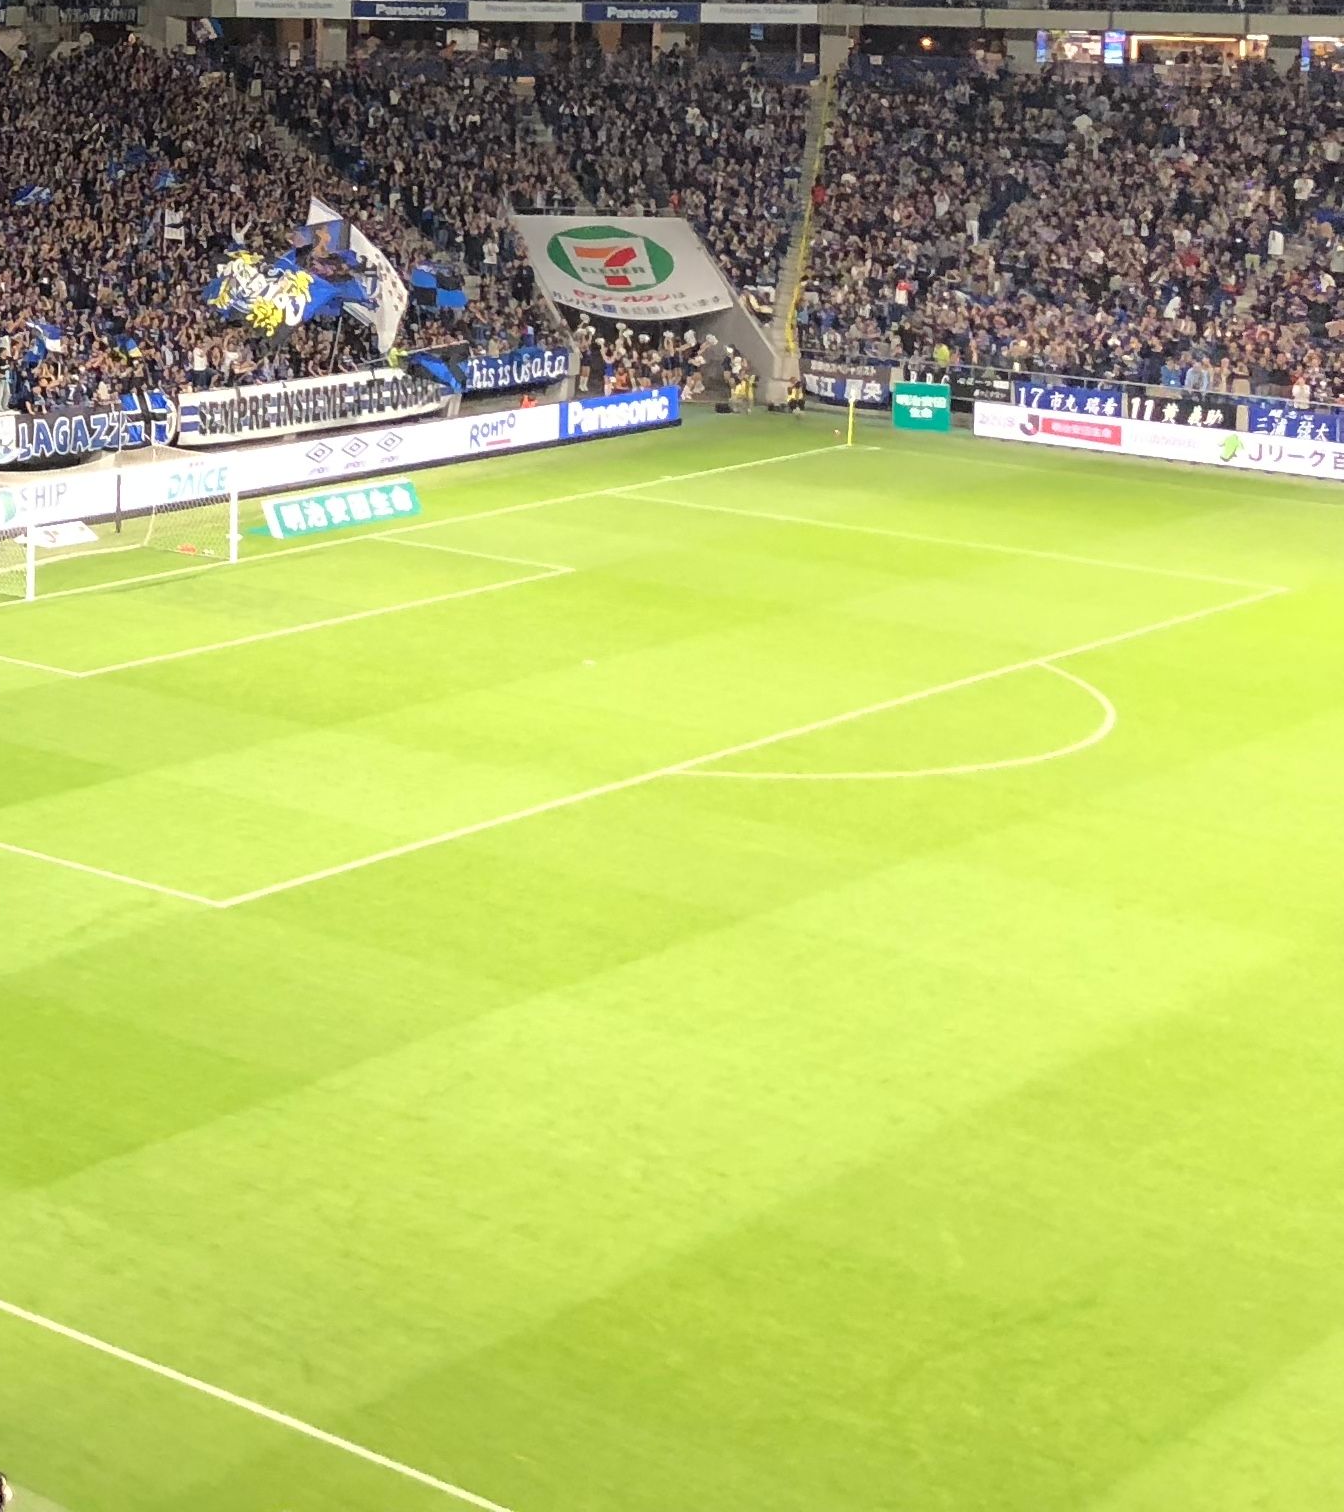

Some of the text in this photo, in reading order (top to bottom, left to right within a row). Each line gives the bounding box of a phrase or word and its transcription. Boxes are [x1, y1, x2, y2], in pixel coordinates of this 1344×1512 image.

[375, 3, 447, 18] Panasonic
[607, 6, 679, 20] Panasonic
[198, 391, 270, 436] SEMPRE
[275, 383, 348, 428] INSIEME
[367, 378, 386, 413] TE
[567, 388, 670, 436] Panasonic
[1017, 386, 1044, 409] 17
[1049, 391, 1078, 414] 市丸
[1130, 395, 1155, 422] 11
[469, 412, 517, 450] ROHTO
